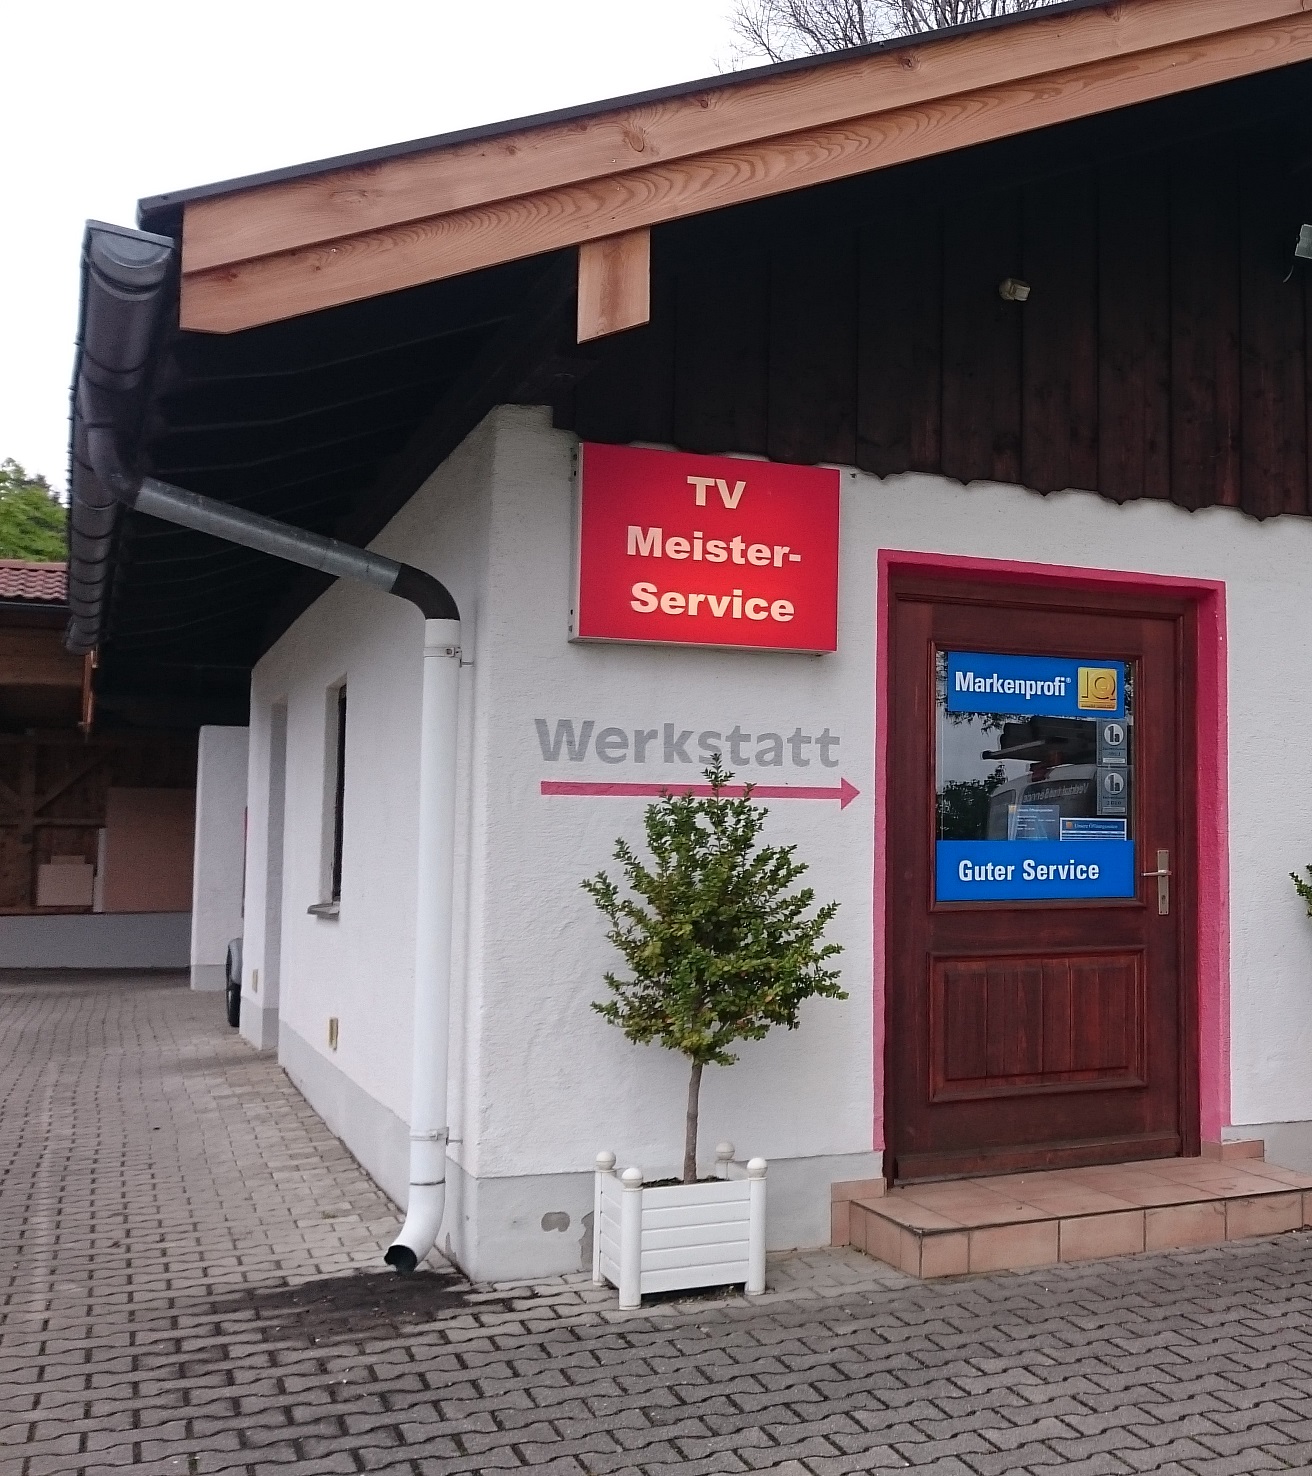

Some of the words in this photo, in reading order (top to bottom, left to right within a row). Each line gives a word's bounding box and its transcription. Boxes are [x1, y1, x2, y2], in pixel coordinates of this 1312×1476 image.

[687, 476, 746, 509] TV
[627, 525, 802, 568] Meister-
[630, 582, 795, 622] Service
[534, 718, 840, 768] Werkstatt
[958, 859, 1015, 881] Guter
[1022, 859, 1100, 880] Service
